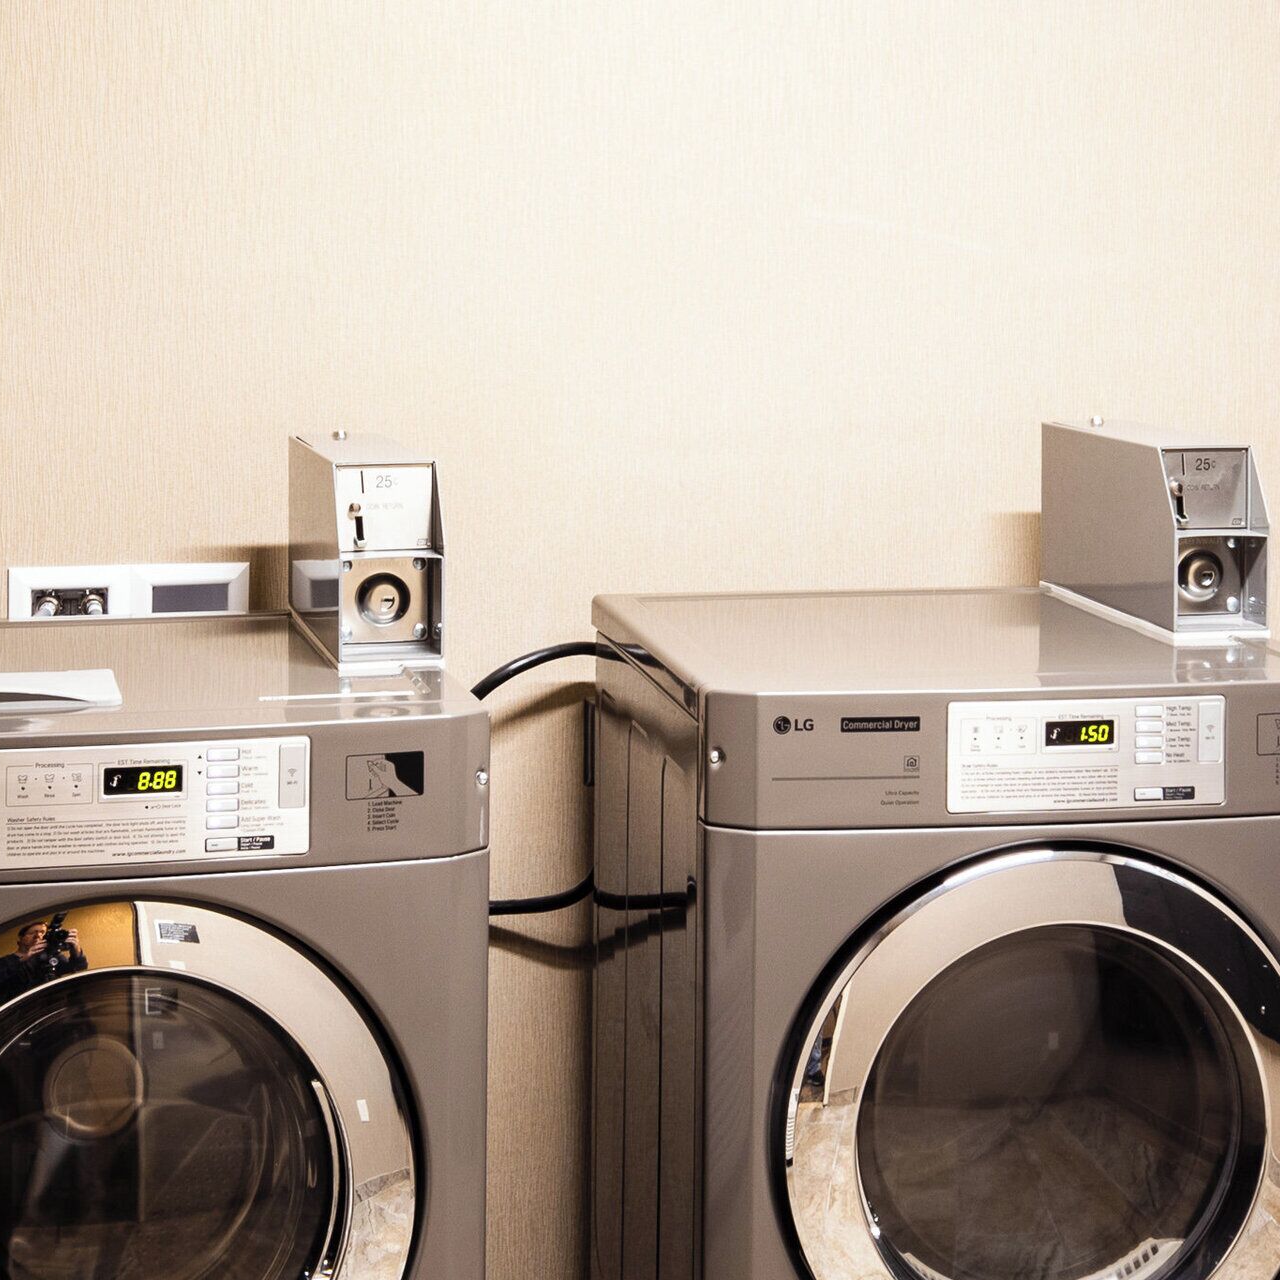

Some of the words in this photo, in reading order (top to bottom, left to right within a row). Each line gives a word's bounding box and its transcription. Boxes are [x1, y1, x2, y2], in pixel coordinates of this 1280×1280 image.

[794, 719, 814, 731] LG
[842, 719, 893, 730] Commercial
[894, 719, 918, 731] Dryer
